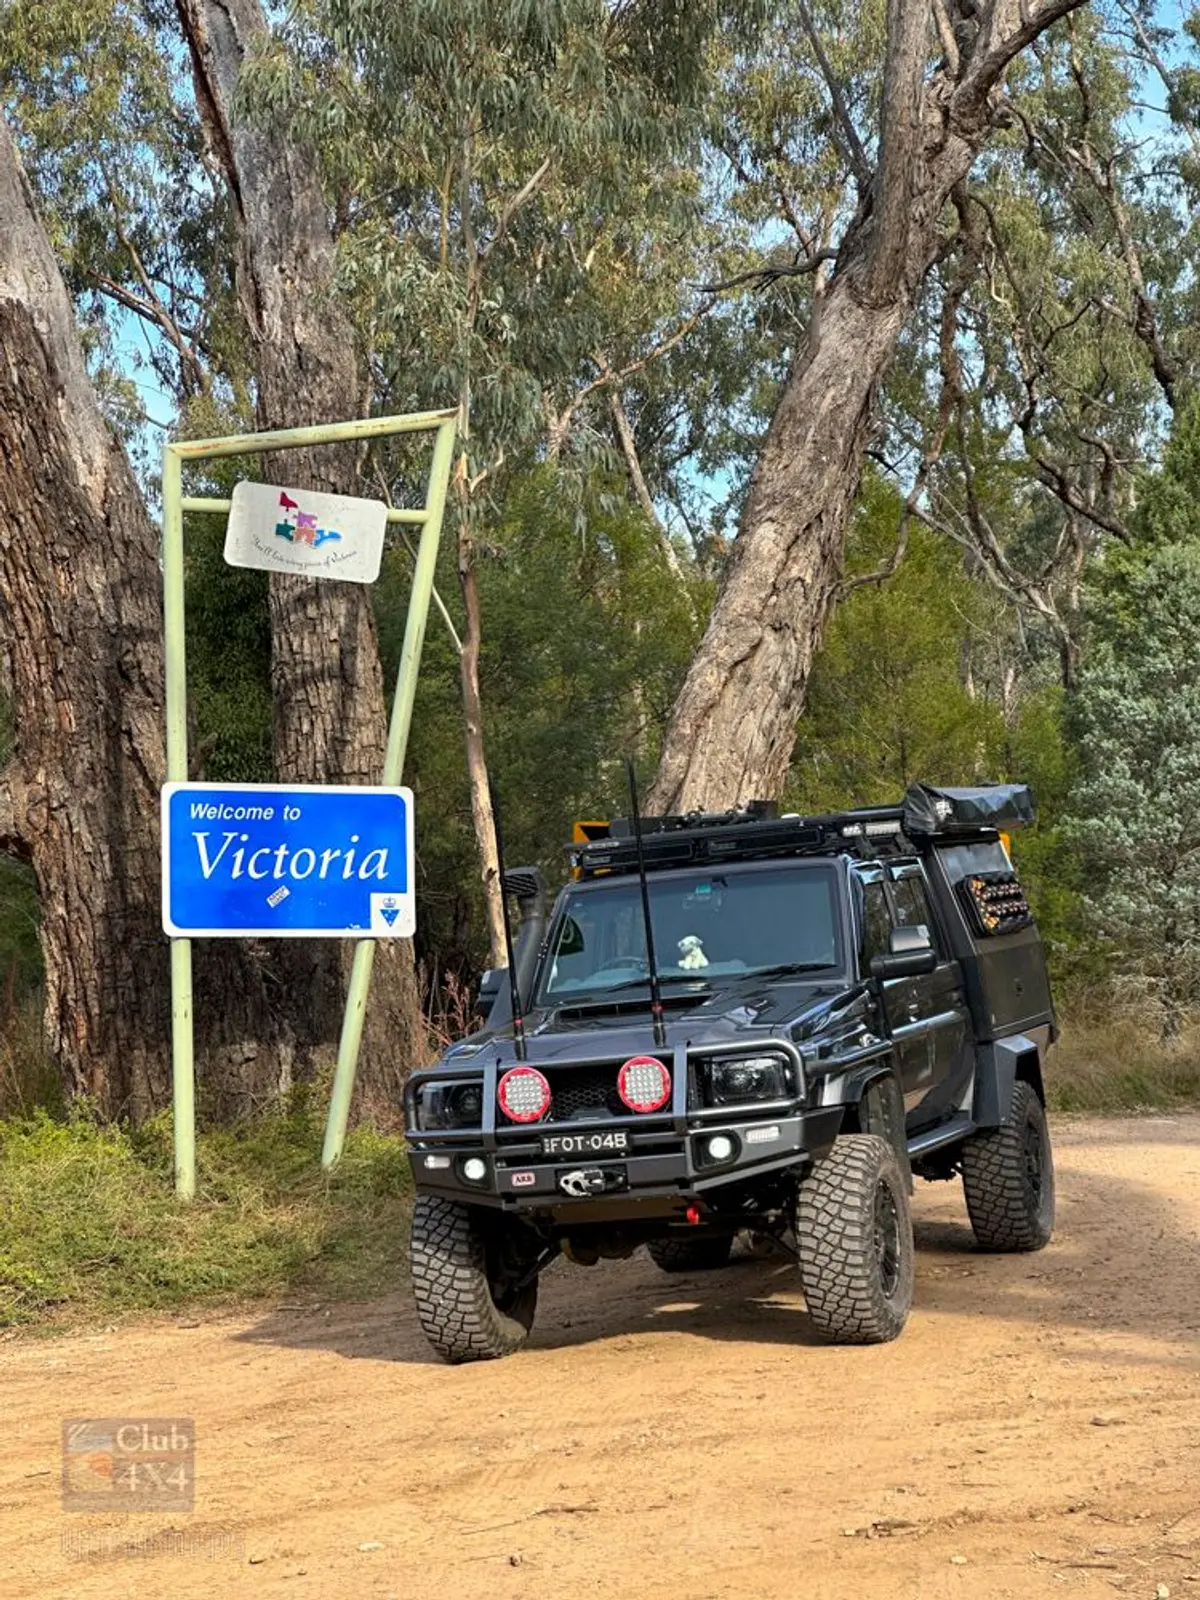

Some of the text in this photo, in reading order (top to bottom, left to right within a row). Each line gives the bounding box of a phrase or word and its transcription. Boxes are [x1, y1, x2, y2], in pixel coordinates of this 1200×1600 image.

[190, 803, 301, 820] Welcome to
[192, 831, 389, 880] Victoria
